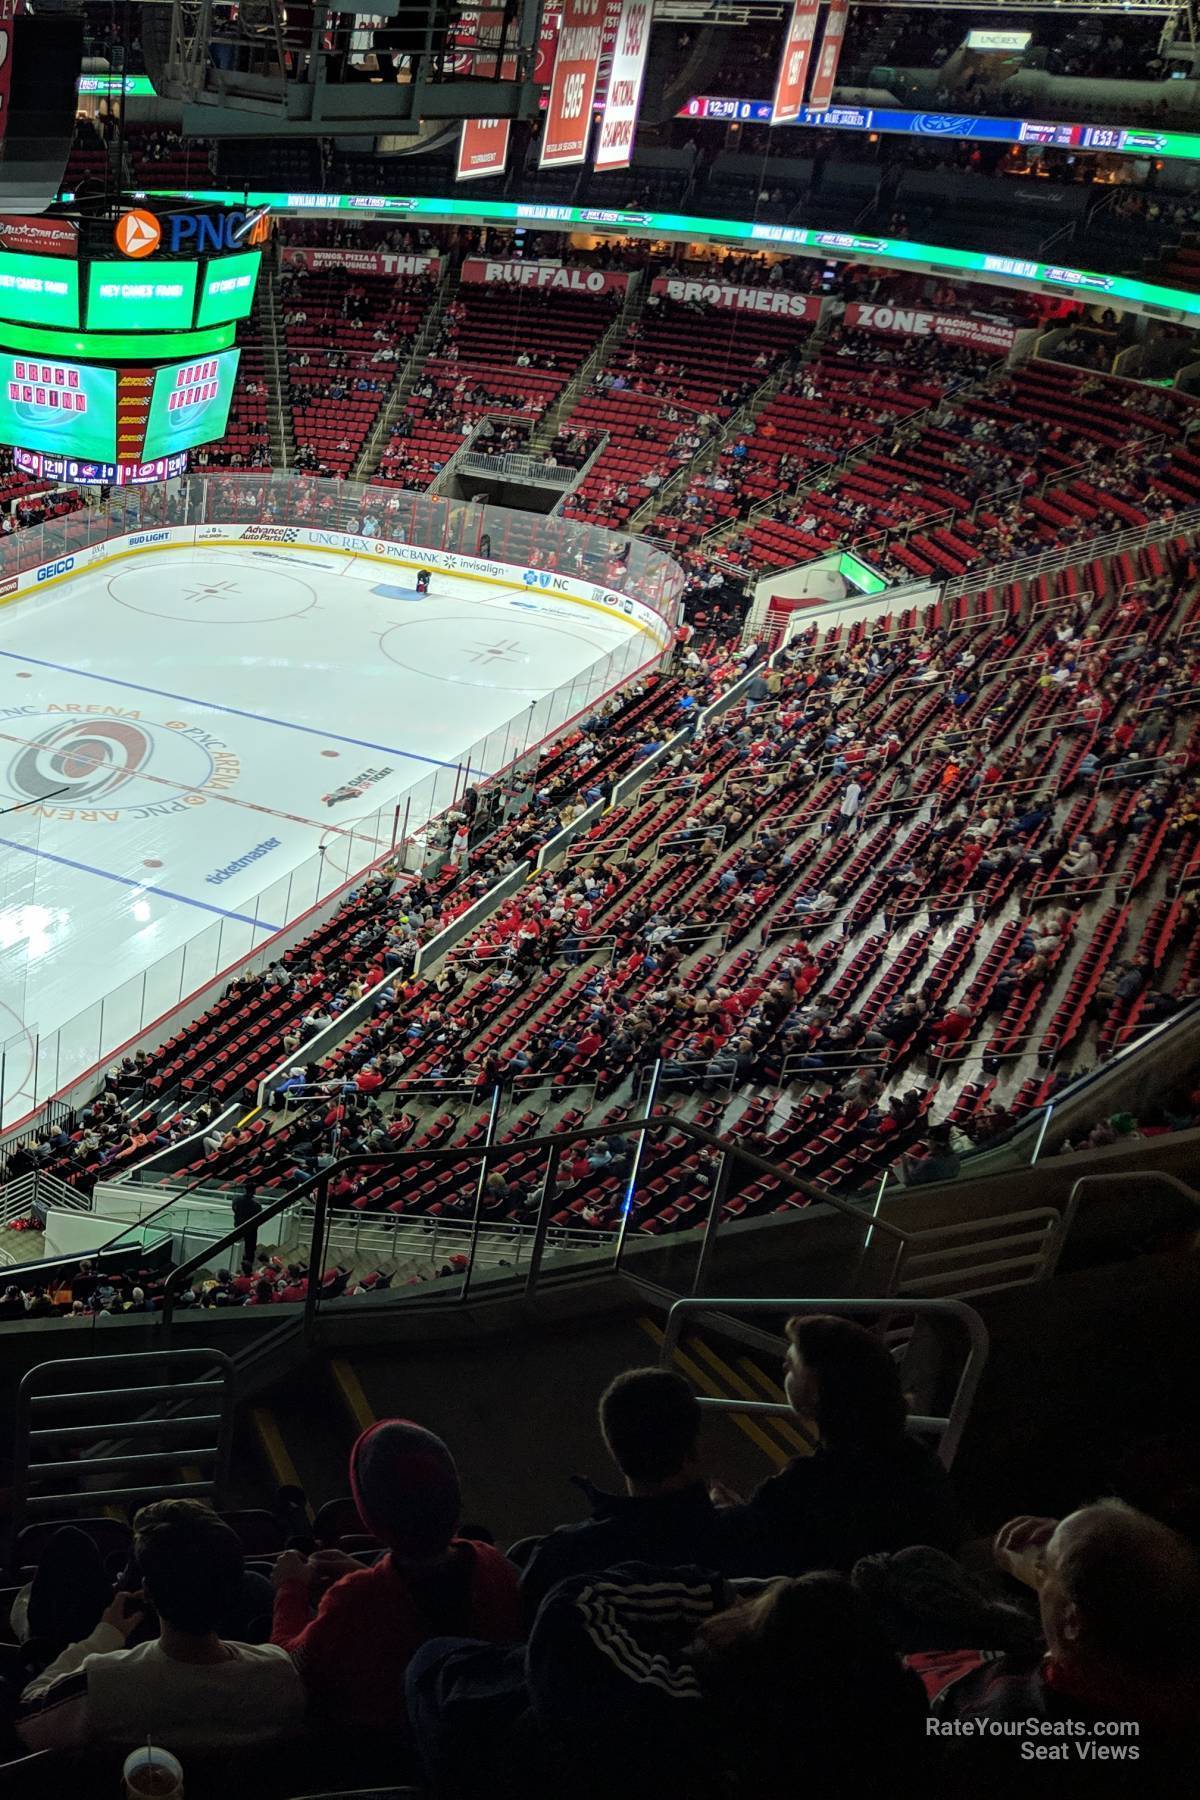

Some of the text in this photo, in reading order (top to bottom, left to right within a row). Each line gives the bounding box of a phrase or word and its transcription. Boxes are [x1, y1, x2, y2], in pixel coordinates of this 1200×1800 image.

[689, 102, 698, 114] 0
[710, 102, 734, 112] 12:10
[741, 104, 750, 117] 0
[169, 211, 246, 252] PNC
[314, 252, 343, 260] WINGS,
[381, 254, 431, 275] THE
[485, 262, 604, 291] BUFFALO
[667, 280, 806, 315] BROTHERS
[858, 304, 935, 334] ZONE
[937, 317, 978, 331] NACHOS,
[982, 325, 1014, 339] WRAPS
[945, 327, 970, 338] TASTY
[971, 333, 1012, 347] GOODNESS
[14, 360, 79, 388] BROCK
[9, 382, 87, 412] MCGINN
[44, 460, 63, 474] 12:10
[70, 463, 78, 476] 0
[129, 532, 170, 546] BUD LIGHT
[245, 526, 285, 535] Advance
[260, 534, 283, 542] Parts
[309, 532, 370, 551] UNC REX
[37, 557, 75, 581] GEICO
[460, 558, 504, 576] invisalign
[553, 577, 570, 591] NC
[47, 703, 142, 720] ARENA
[182, 727, 241, 790] PNC ARENA
[348, 773, 371, 787] CLICK
[370, 767, 395, 784] TICKET
[12, 802, 192, 822] PNC ARENA
[206, 836, 282, 885] ticketmaster
